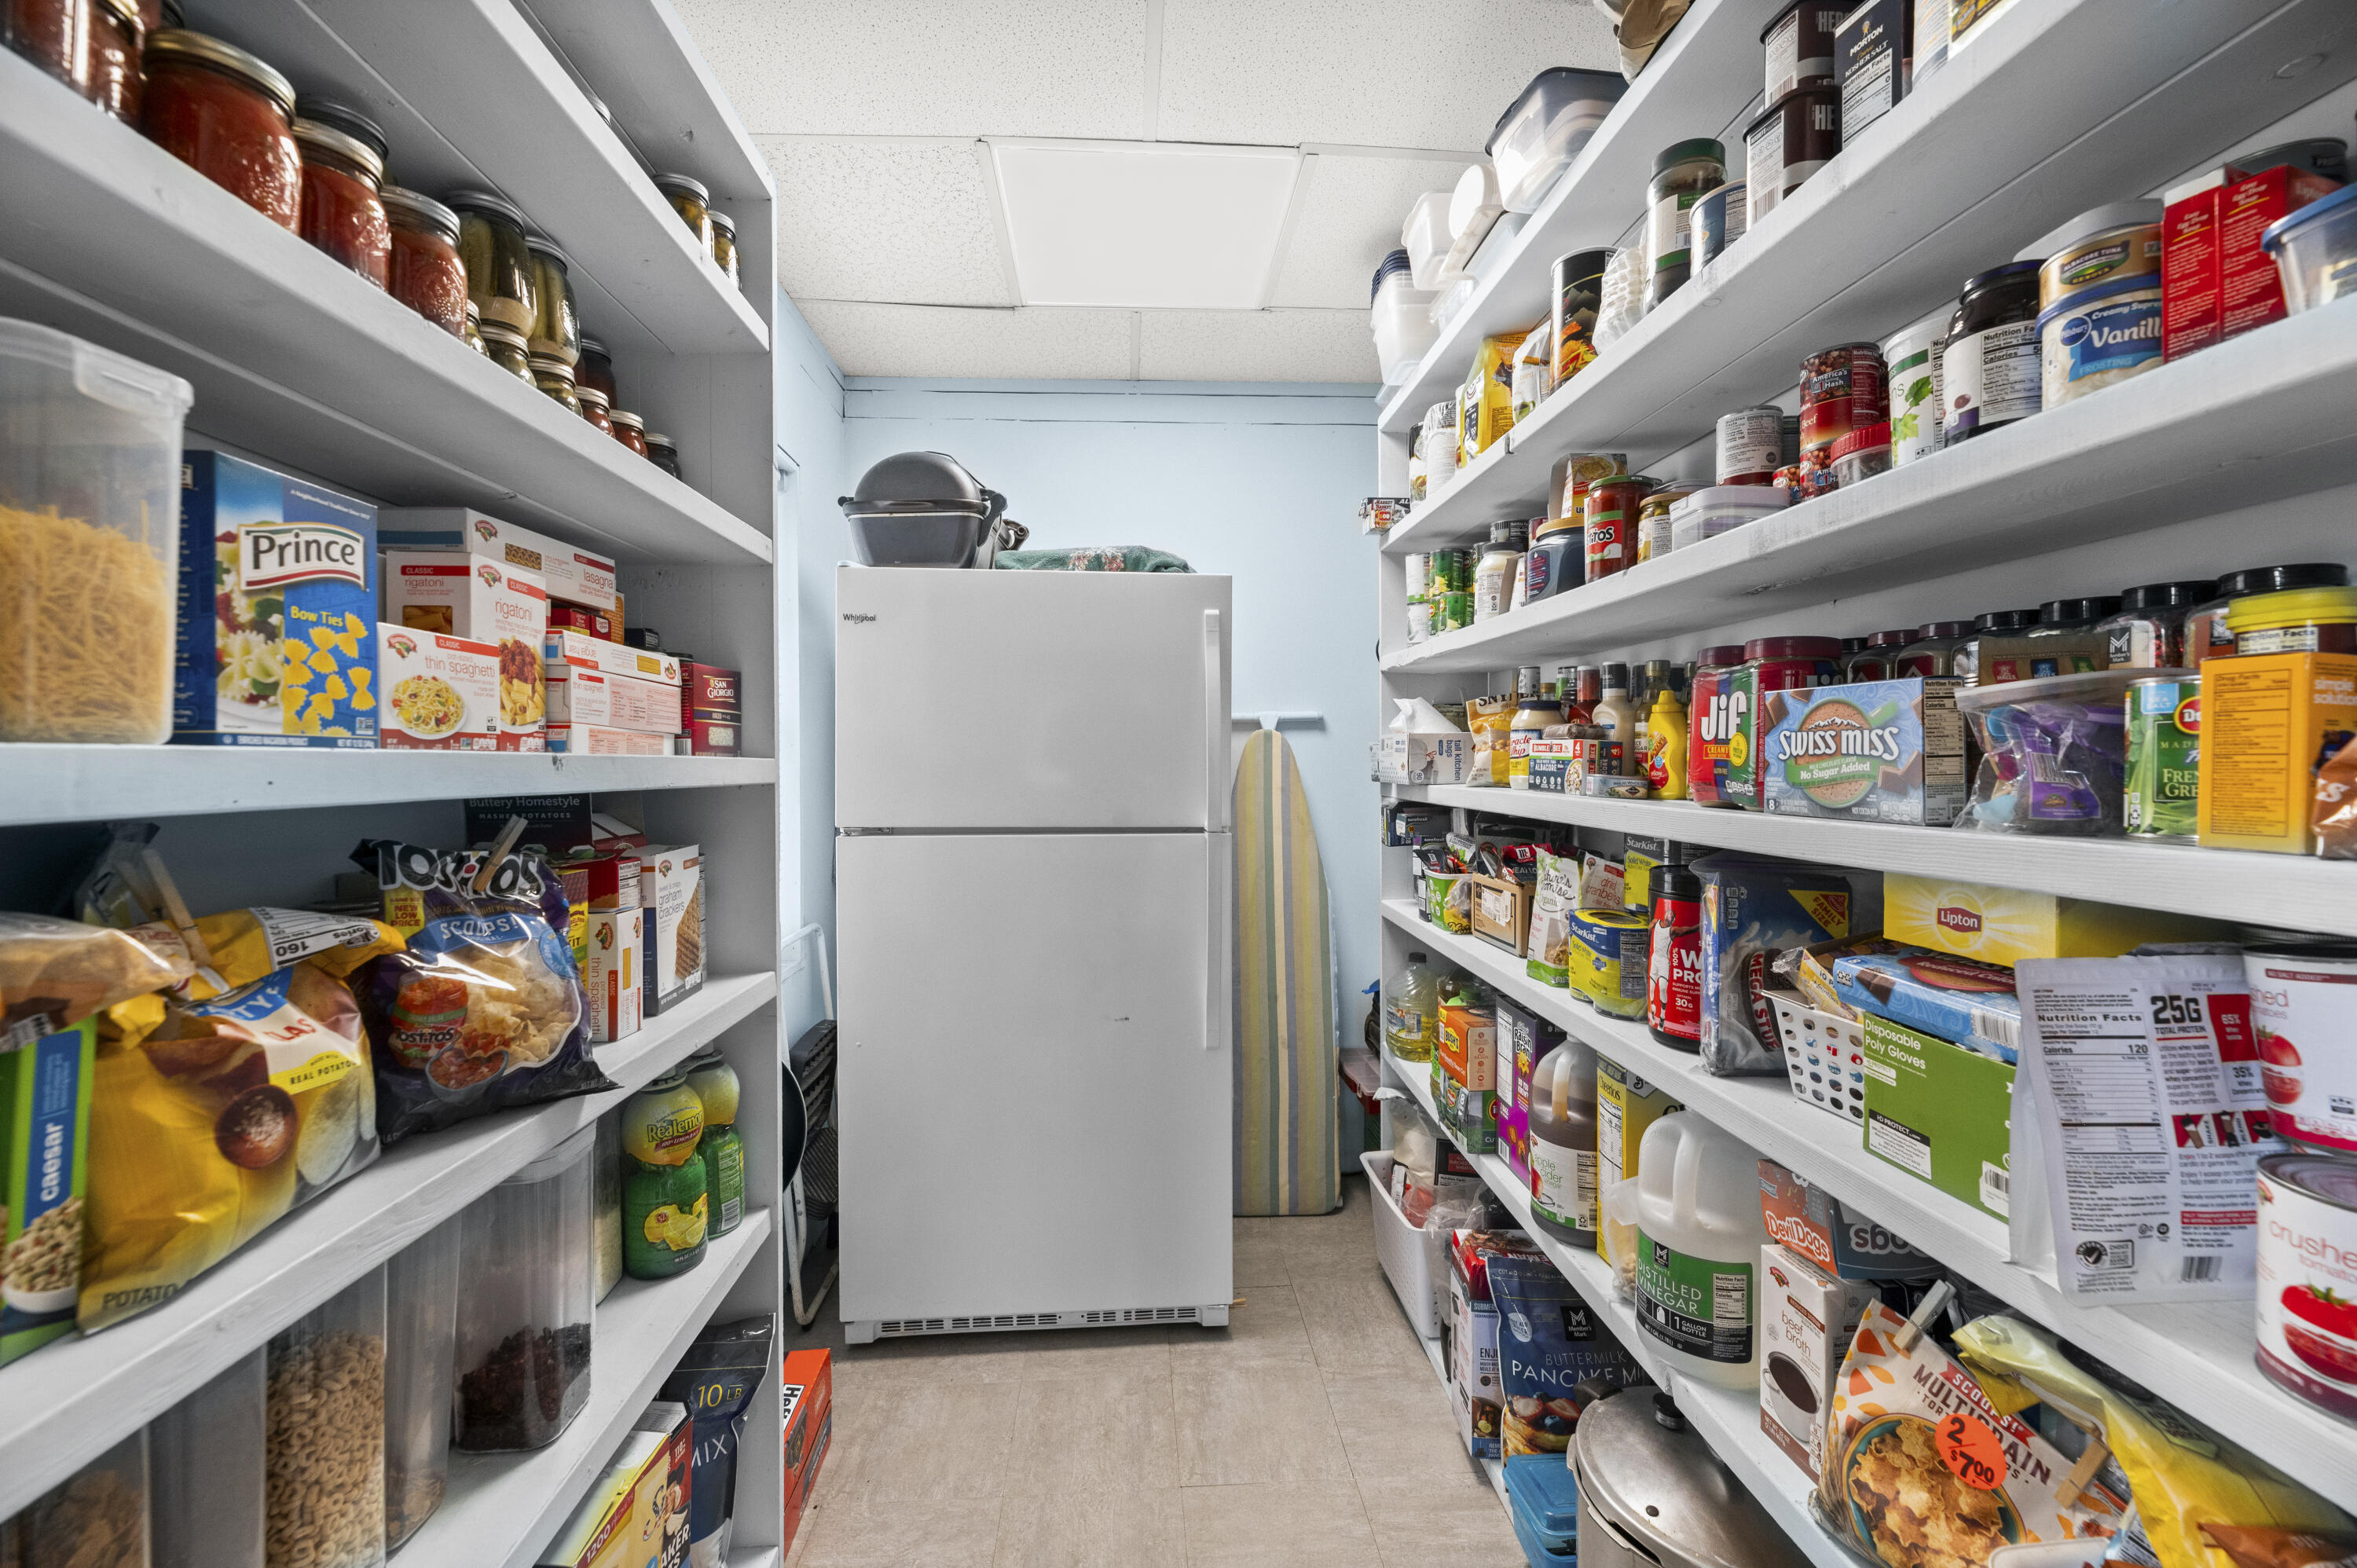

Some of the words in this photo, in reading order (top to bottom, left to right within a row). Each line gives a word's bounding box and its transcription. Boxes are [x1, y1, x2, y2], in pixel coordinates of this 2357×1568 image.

[1849, 24, 1884, 57] MORTON
[1845, 55, 1871, 78] KOSHER
[1871, 40, 1890, 57] SALT
[1843, 65, 1870, 91] Nutrition
[1871, 51, 1891, 69] Facts
[2063, 251, 2101, 271] ALBACORE
[2101, 245, 2122, 256] TUNA
[2092, 303, 2131, 321] Creamy
[1983, 328, 2022, 343] Nutrition
[2091, 317, 2161, 348] Vanill
[1983, 350, 2018, 364] Calories
[2080, 357, 2132, 376] FROSTING
[1813, 368, 1848, 383] America's
[1825, 379, 1844, 390] Hash
[252, 531, 356, 570] Prince
[405, 577, 444, 589] rigatoni
[510, 581, 528, 593] CLASSIC
[584, 568, 614, 589] lasagna
[290, 606, 317, 622] Bow
[320, 611, 343, 627] Ties
[495, 598, 533, 621] rigatoni
[842, 613, 876, 625] Whirlpool
[439, 639, 461, 649] CLASSIC
[424, 655, 446, 671] thin
[449, 660, 496, 681] spaghetti
[707, 687, 734, 698] GIORGIO
[714, 680, 727, 689] SAN
[2314, 678, 2355, 692] simple
[1701, 691, 1747, 741] Jif
[1533, 744, 1550, 753] BUMBLE
[1552, 743, 1563, 753] BEE
[1574, 742, 1581, 751] 4
[1778, 730, 1837, 760] SWISS
[1840, 727, 1900, 760] MISS
[1535, 763, 1557, 772] ALBACORE
[1800, 770, 1811, 780] No
[1813, 765, 1840, 779] Sugar
[1841, 761, 1871, 774] Added
[1819, 759, 1842, 769] CHOCOLATE
[1841, 756, 1857, 765] FLAVOR
[2162, 768, 2199, 783] FREN
[471, 797, 512, 808] Buttery
[516, 796, 581, 808] Homestyle
[1769, 798, 1776, 810] 8
[1626, 836, 1659, 852] StarKist
[1628, 855, 1639, 864] Solid
[658, 888, 683, 907] graham
[394, 904, 418, 913] NEW
[658, 901, 685, 919] crackers
[1811, 907, 1831, 928] SIZE
[1812, 896, 1845, 927] FAMILY
[390, 919, 421, 928] PRICE
[1940, 910, 1978, 929] Lipton
[1571, 922, 1596, 943] StarKist
[276, 940, 309, 957] 160
[590, 957, 602, 979] thin
[1749, 952, 1765, 1003] MEGA
[1916, 961, 1977, 976] Reduced
[1672, 981, 1694, 990] SUPPORTS
[590, 982, 602, 1036] spaghetti
[1675, 998, 1688, 1007] 30
[2150, 995, 2202, 1024] 25G
[2102, 1013, 2143, 1022] Facts
[2221, 1014, 2242, 1025] 65%
[1754, 1008, 1781, 1051] STUF
[1864, 1019, 1922, 1051] Disposable
[1445, 1029, 1460, 1050] BUSH'S
[1513, 1027, 1532, 1053] Raisin
[2043, 1046, 2073, 1054] Calories
[2128, 1044, 2149, 1053] 120
[1516, 1041, 1531, 1062] Bran
[1864, 1035, 1885, 1053] Poly
[1887, 1045, 1926, 1070] Gloves
[289, 1072, 314, 1085] REAL
[317, 1059, 357, 1078] POTATO
[2232, 1067, 2255, 1079] 35%
[1598, 1073, 1621, 1101] Cheerios
[647, 1110, 703, 1142] ReaLemon
[1885, 1116, 1910, 1135] PROTECT
[40, 1121, 65, 1203] caesar
[1534, 1152, 1556, 1172] apple
[1540, 1167, 1563, 1183] cider
[1638, 1258, 1702, 1300] DISTILLED
[1653, 1263, 1671, 1277] WHITE
[1639, 1272, 1699, 1315] VINEGAR
[1673, 1316, 1680, 1329] 1
[1681, 1321, 1706, 1332] GALLON
[1681, 1326, 1706, 1337] BOTTLE
[1781, 1310, 1804, 1337] beef
[1785, 1326, 1812, 1358] broth
[1545, 1350, 1627, 1367] BUTTERMILK
[698, 1383, 723, 1409] 10
[726, 1387, 742, 1401] LB
[1952, 1372, 2019, 1434] SCOOS!
[585, 1524, 611, 1563] 1200
